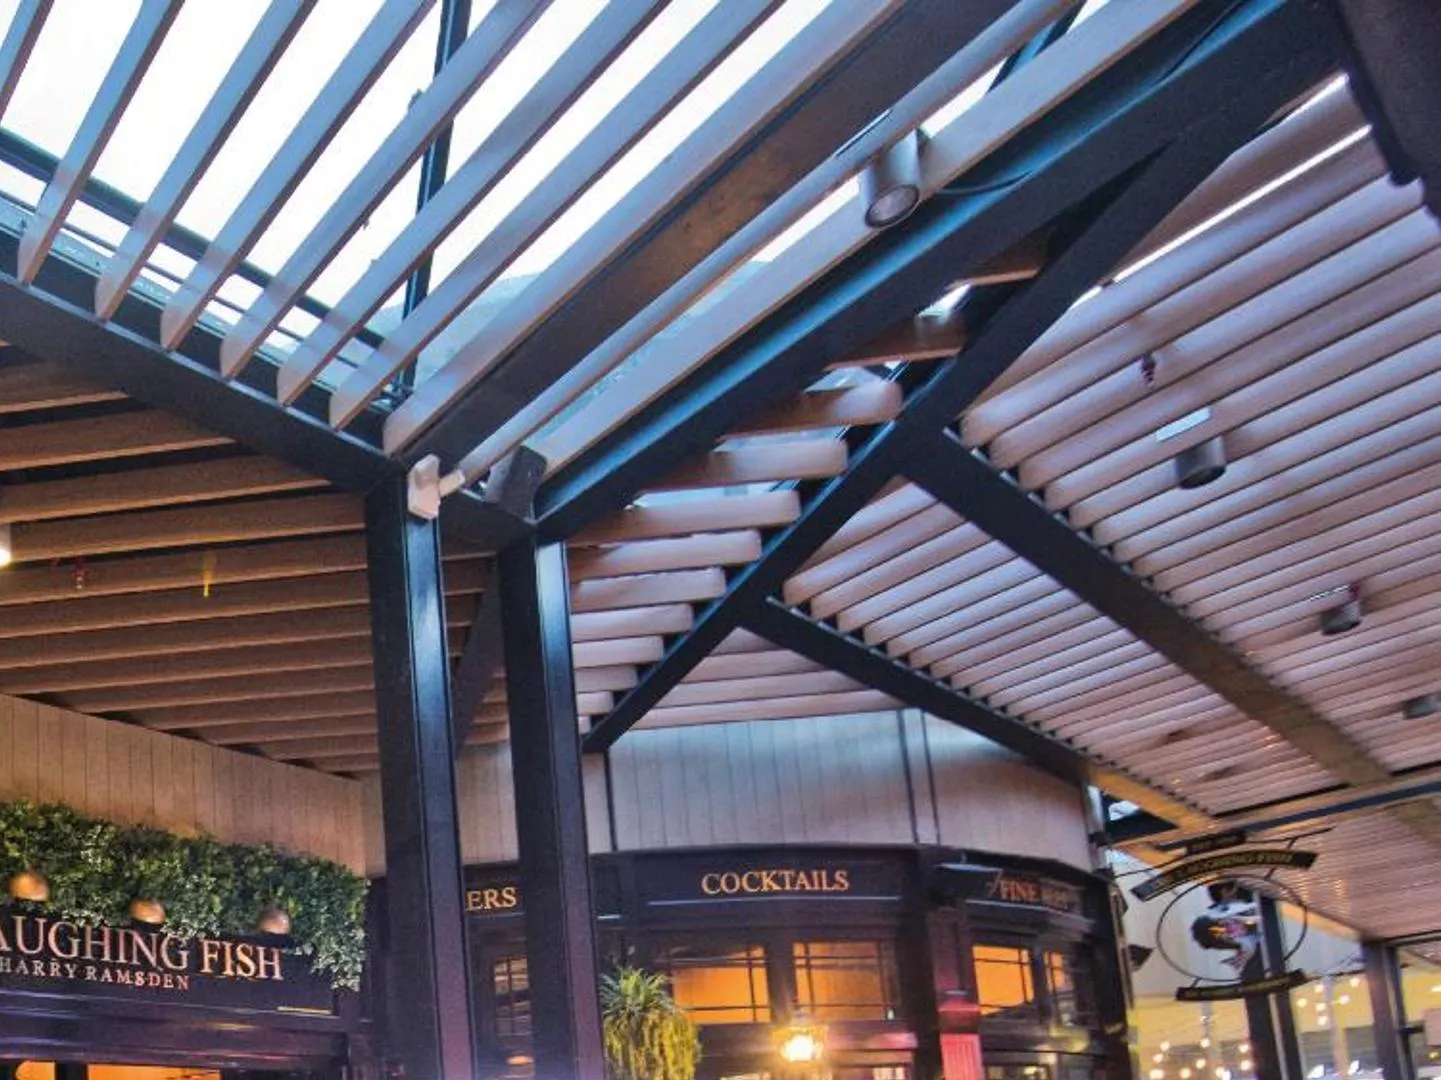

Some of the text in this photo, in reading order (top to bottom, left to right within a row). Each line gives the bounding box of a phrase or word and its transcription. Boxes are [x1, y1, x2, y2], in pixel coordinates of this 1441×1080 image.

[701, 869, 850, 895] COCKTAILS
[199, 938, 284, 981] FISH
[86, 964, 190, 990] RAMSDEN
